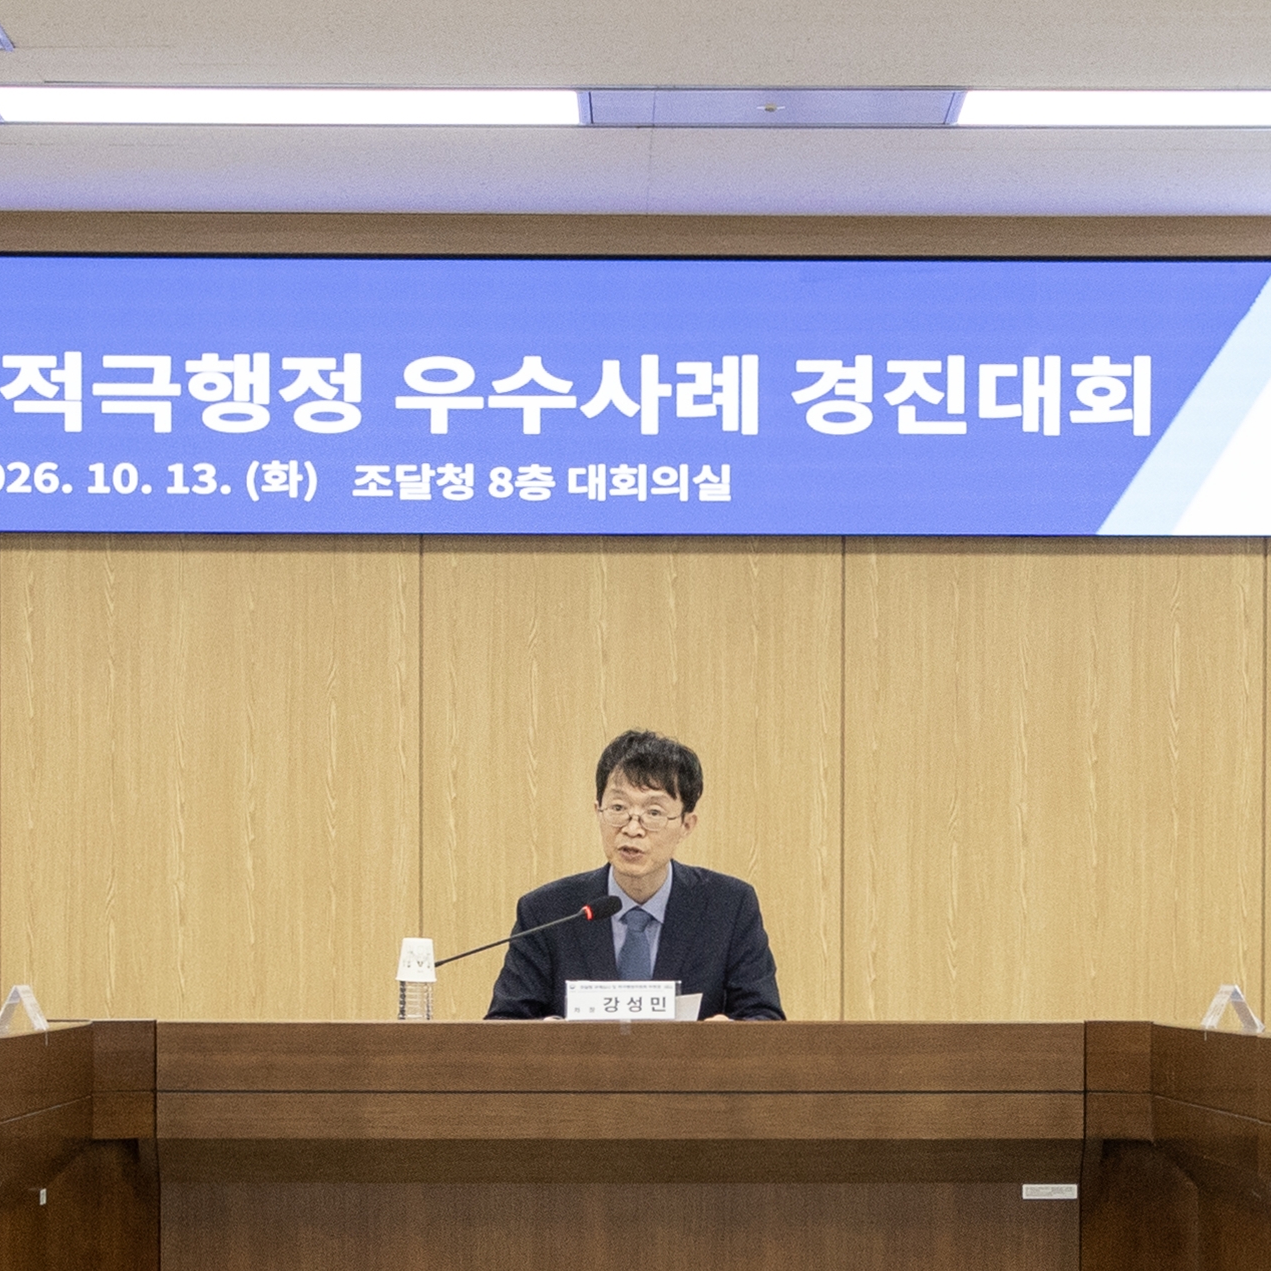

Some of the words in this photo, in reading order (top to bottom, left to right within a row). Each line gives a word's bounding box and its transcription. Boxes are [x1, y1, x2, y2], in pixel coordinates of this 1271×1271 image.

[394, 353, 760, 436] 우수사례
[790, 353, 1154, 437] 경진대회
[86, 461, 153, 496] 10.
[165, 461, 232, 496] 13.
[245, 458, 319, 503] (화)
[351, 461, 475, 502] 조달청
[487, 462, 557, 502] 8층
[567, 462, 733, 503] 대회의실
